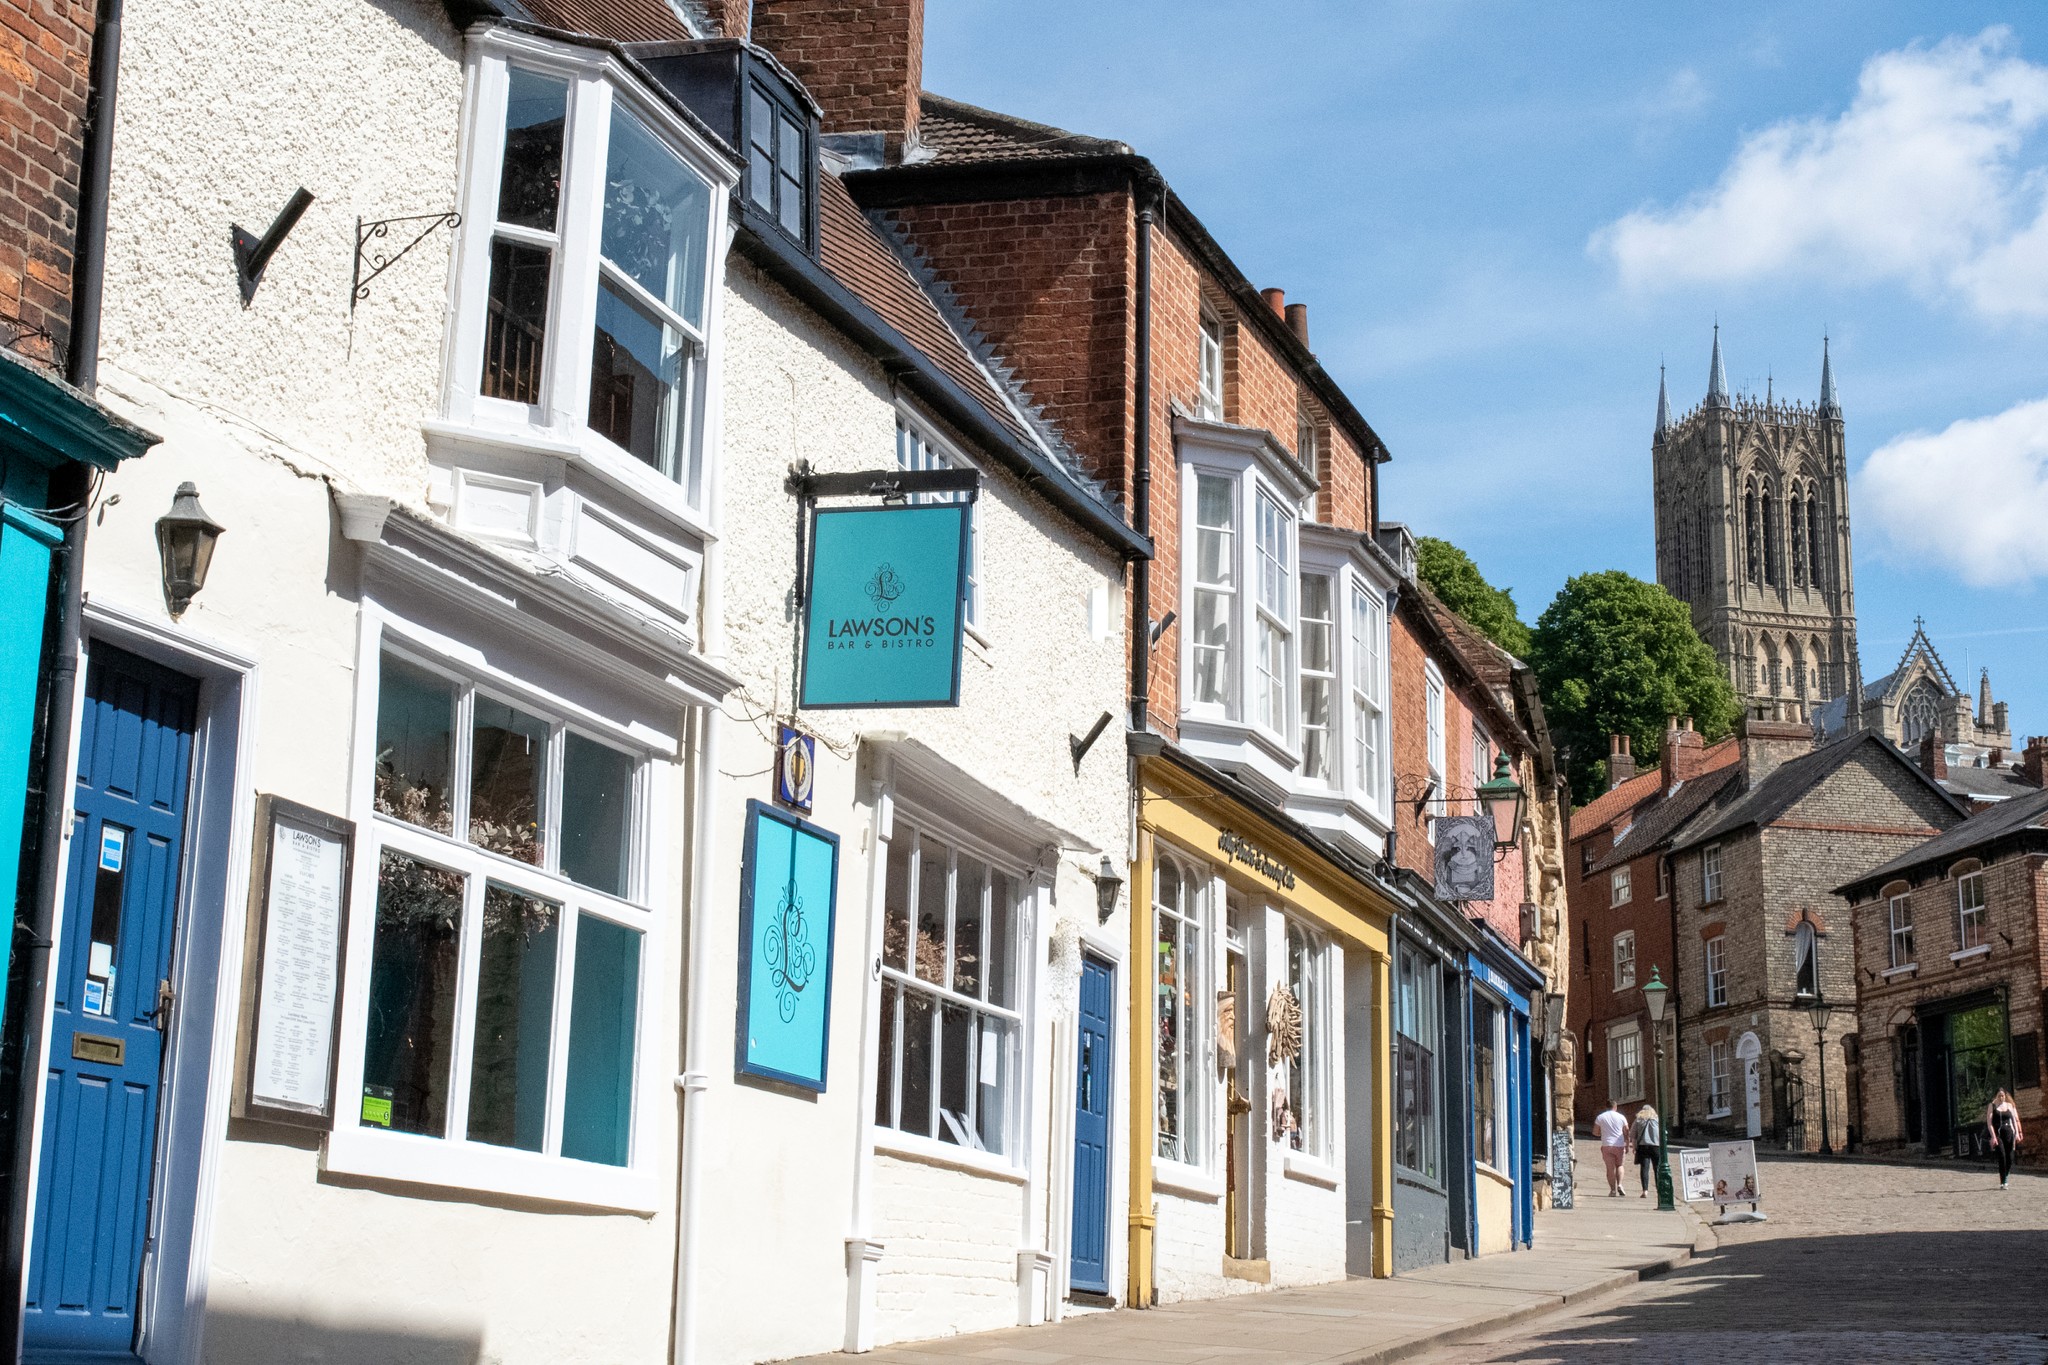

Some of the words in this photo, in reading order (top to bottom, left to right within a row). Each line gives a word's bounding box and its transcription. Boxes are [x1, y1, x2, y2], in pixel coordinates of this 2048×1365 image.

[828, 615, 935, 638] LAWSON'S
[827, 641, 855, 650] BAR
[864, 640, 873, 649] &
[881, 639, 934, 649] BISTRO
